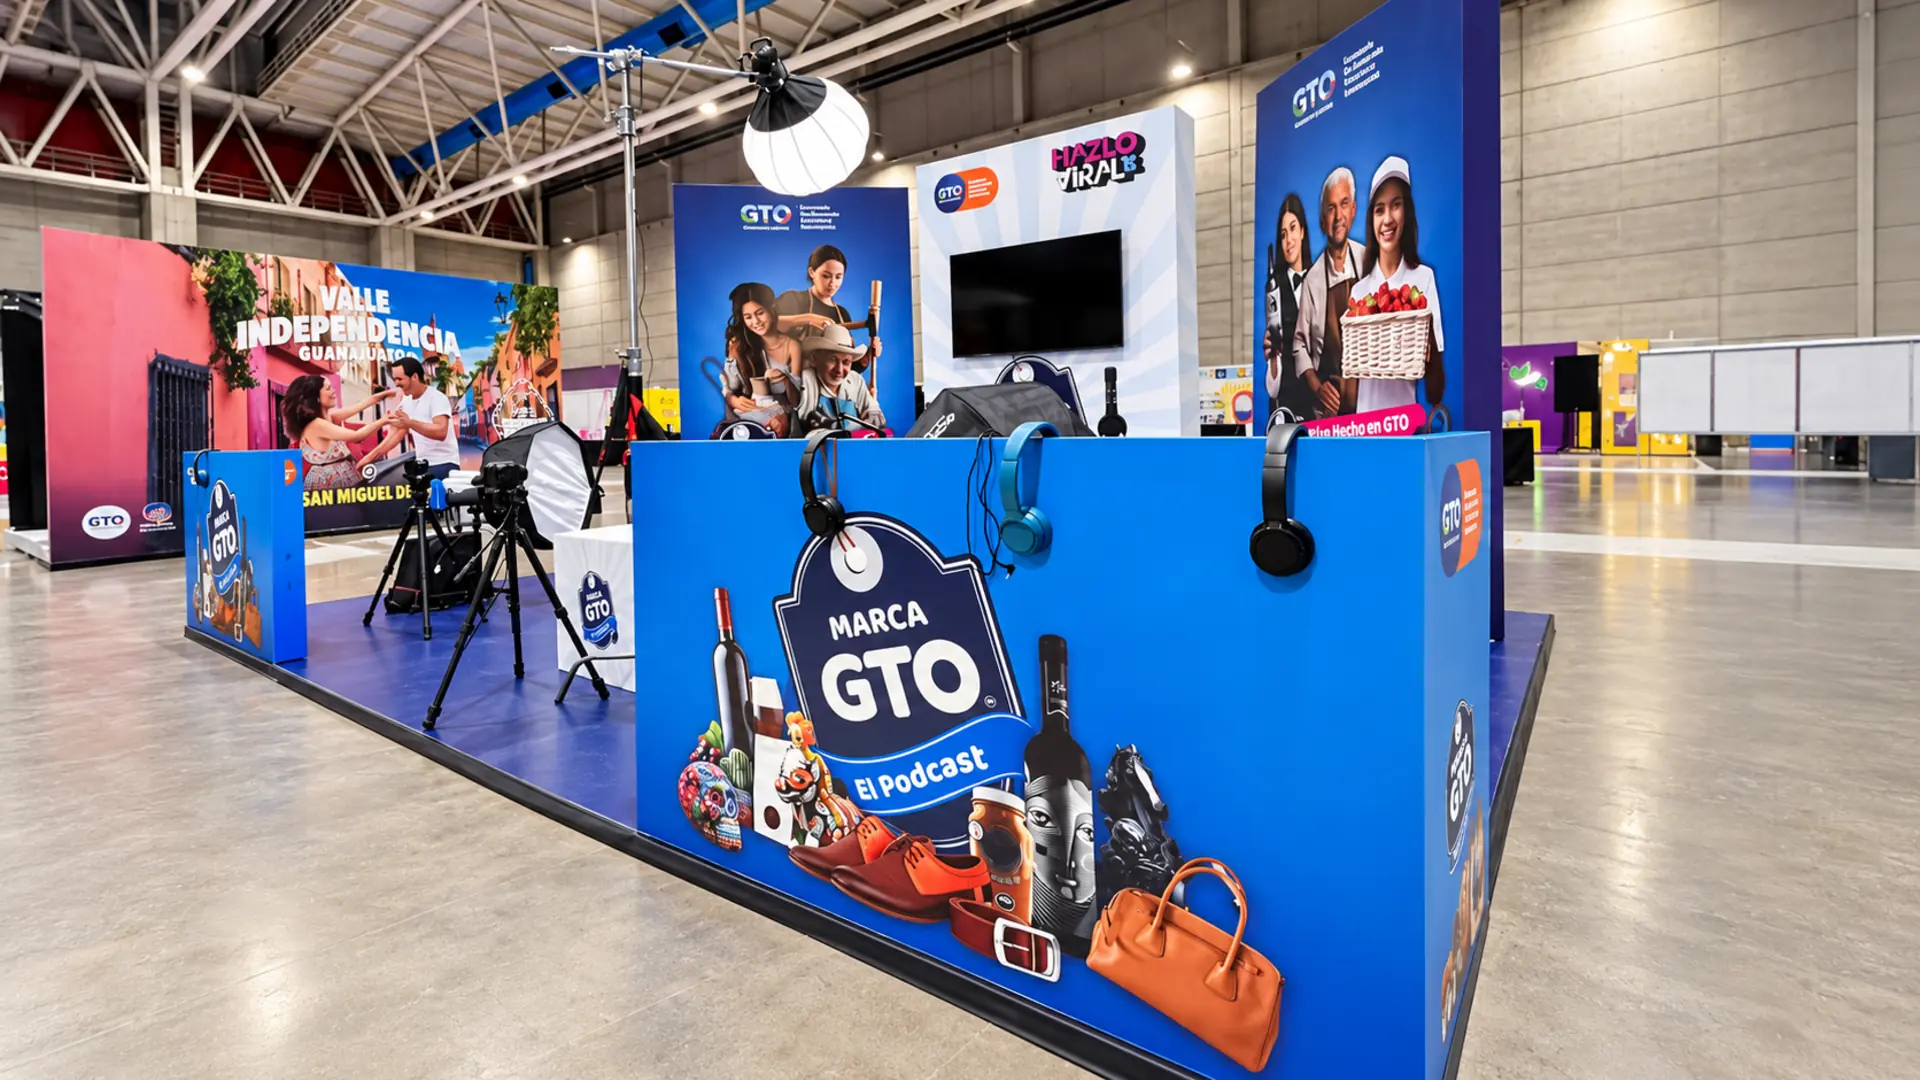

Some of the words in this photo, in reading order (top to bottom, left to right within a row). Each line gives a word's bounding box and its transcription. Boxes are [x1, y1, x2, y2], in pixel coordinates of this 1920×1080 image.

[1292, 69, 1336, 117] GTO
[1052, 131, 1139, 171] HAZLO
[938, 184, 963, 200] GTO
[741, 204, 792, 224] GTO
[319, 285, 390, 314] VALLE
[236, 315, 462, 360] INDEPENDENCIA
[1332, 420, 1366, 437] Hecho
[1367, 421, 1381, 433] en
[1383, 413, 1409, 432] GTO
[302, 490, 334, 508] SAN
[337, 484, 393, 505] MIGUEL
[395, 484, 413, 499] DE
[88, 515, 125, 527] GTO
[1442, 497, 1461, 536] GTO
[212, 524, 237, 562] GTO
[585, 598, 610, 622] GTO
[828, 600, 929, 641] MARCA
[821, 638, 981, 722] GTO
[854, 776, 879, 801] El
[878, 745, 989, 798] Podcast
[1450, 742, 1472, 822] GTO
